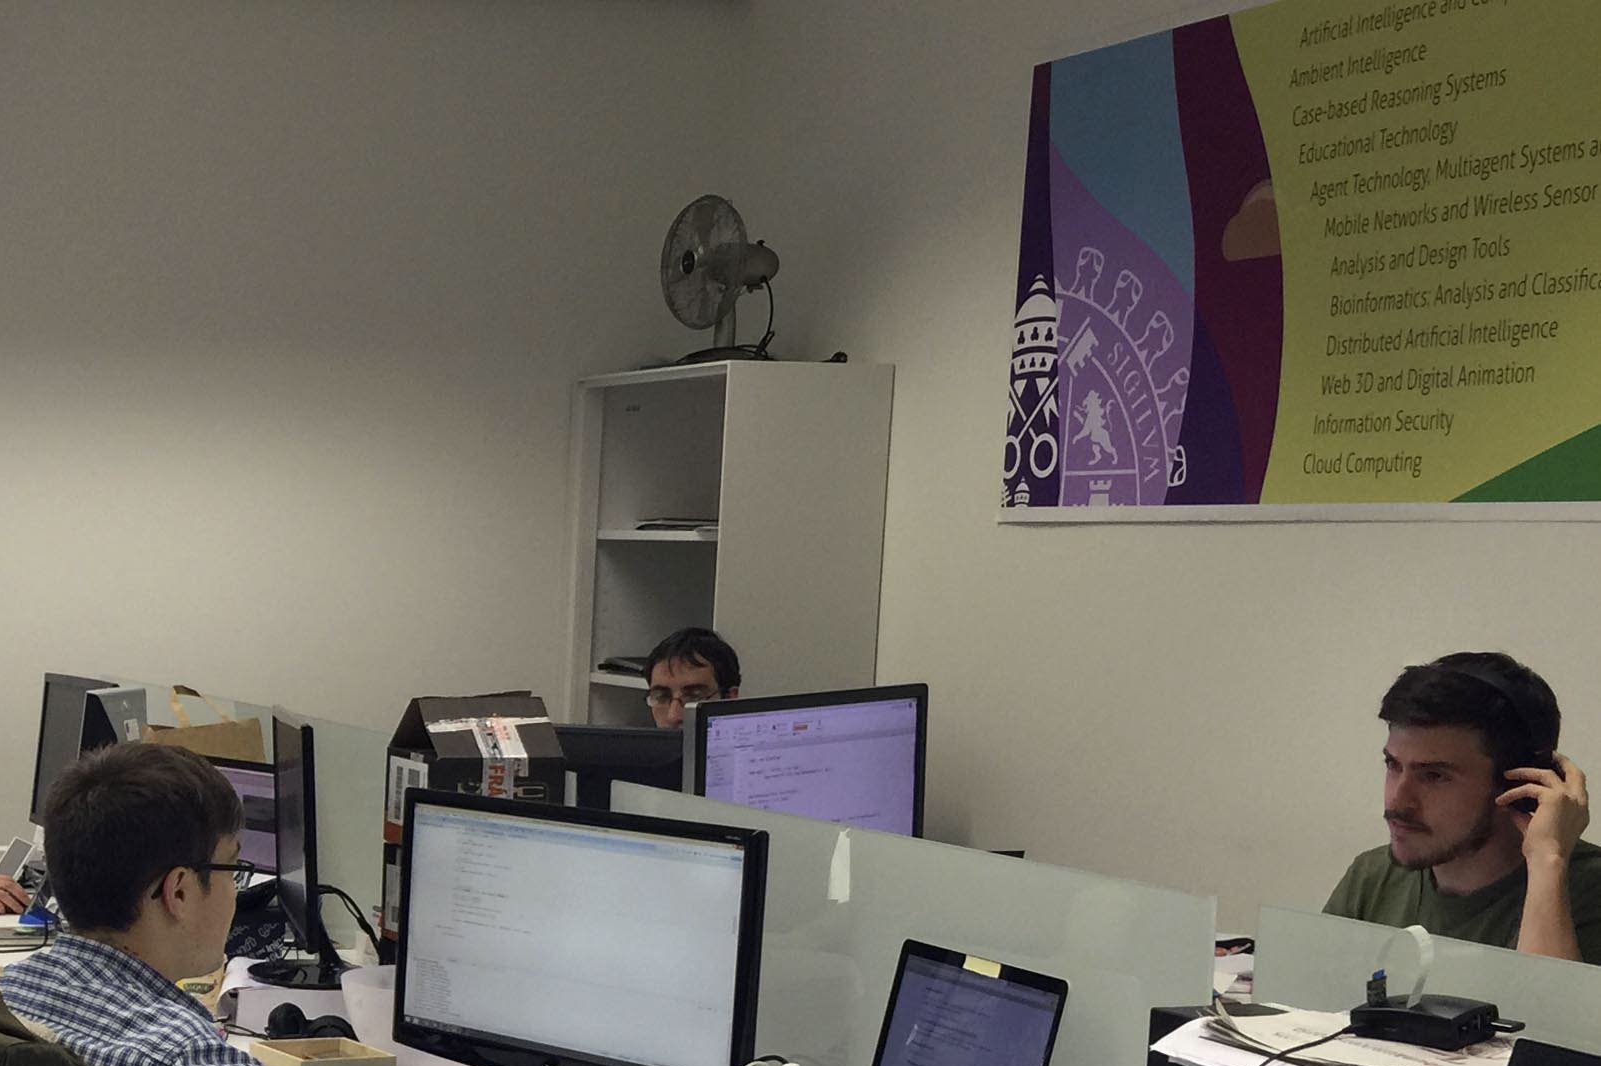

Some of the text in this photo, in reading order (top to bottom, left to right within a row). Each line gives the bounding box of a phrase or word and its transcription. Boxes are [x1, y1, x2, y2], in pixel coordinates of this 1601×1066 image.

[1299, 20, 1353, 48] Artificial
[1356, 2, 1436, 32] Intelligence
[1289, 43, 1428, 88] Ambient Intelligence
[1292, 66, 1507, 127] Case-based Reasoning Systems
[1298, 118, 1458, 164] Educational Technology
[1310, 179, 1348, 207] Agent
[1435, 152, 1517, 182] Multiagent
[1519, 140, 1586, 174] Systems
[1589, 139, 1601, 158] a
[1324, 182, 1598, 239] Mobile Networks and Wireless Sensor
[1329, 234, 1511, 281] Analysis and Design Tools
[1434, 280, 1495, 310] Analysis
[1498, 273, 1527, 299] and
[1326, 319, 1559, 357] Distributed Artificial Intelligence
[1321, 361, 1535, 396] Web 3D and Digital Animation
[1313, 408, 1454, 437] Information Security
[1303, 450, 1423, 479] Cloud Computing
